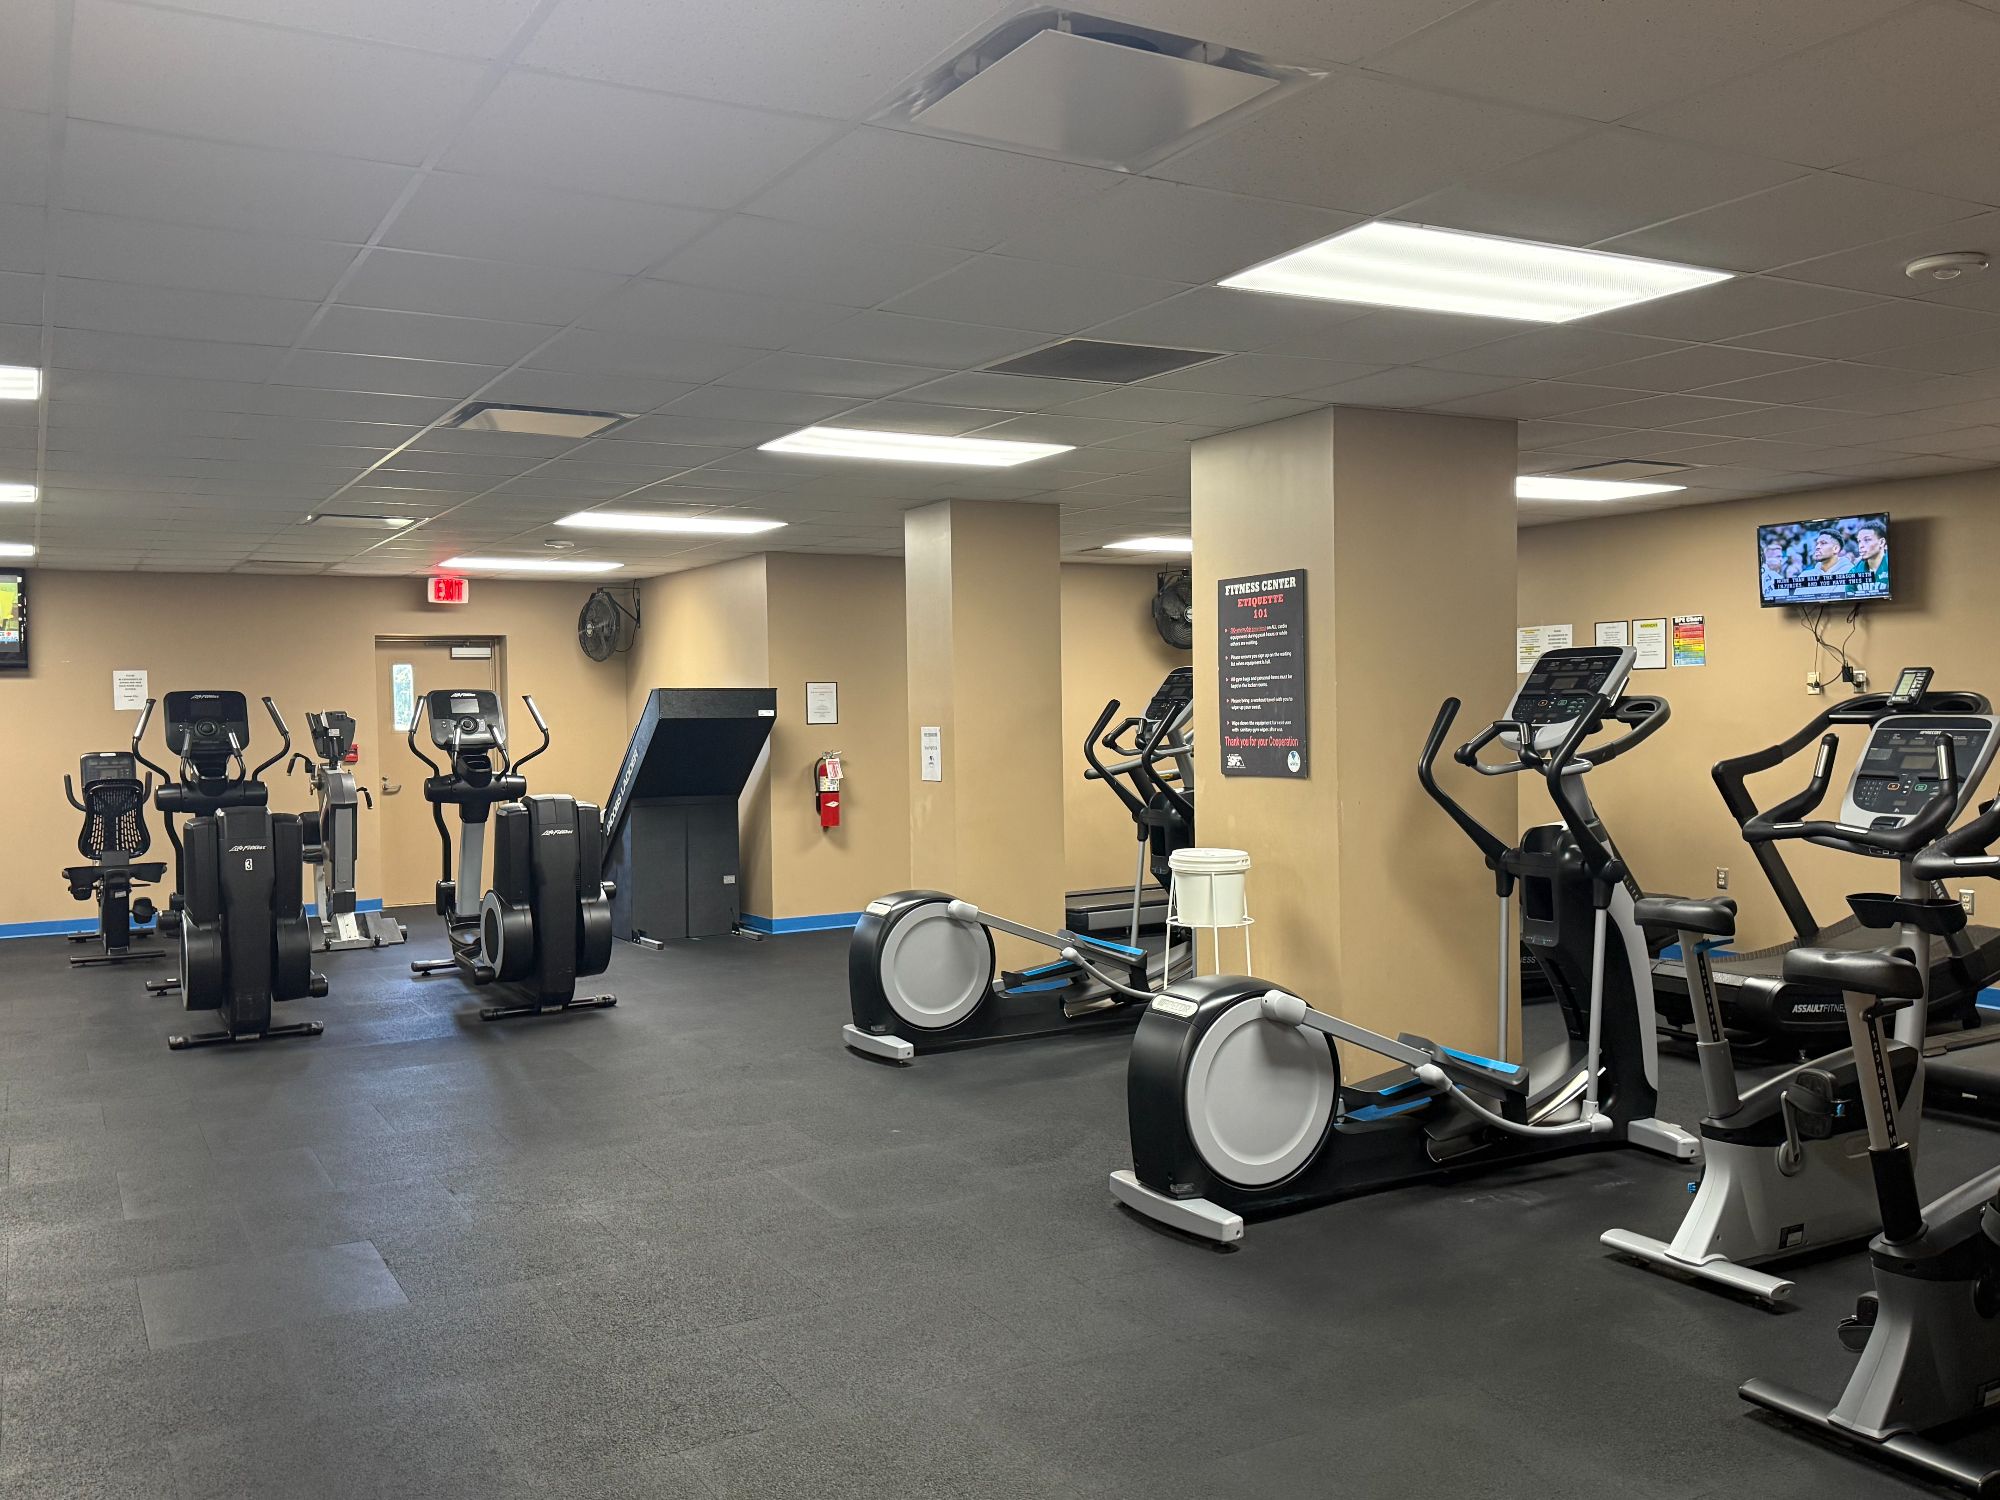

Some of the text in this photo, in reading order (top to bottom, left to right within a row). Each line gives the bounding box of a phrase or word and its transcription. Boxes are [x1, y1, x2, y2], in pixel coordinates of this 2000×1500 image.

[434, 579, 464, 601] EXIT
[1225, 577, 1296, 596] FITNESS CENTER
[1237, 594, 1284, 607] ETIQUETTE
[1253, 608, 1268, 619] 101
[1225, 735, 1240, 747] Thank
[1240, 738, 1249, 749] you
[1257, 738, 1268, 749] your
[1268, 735, 1299, 748] Cooperation
[606, 747, 639, 837] JACOBS LADDER
